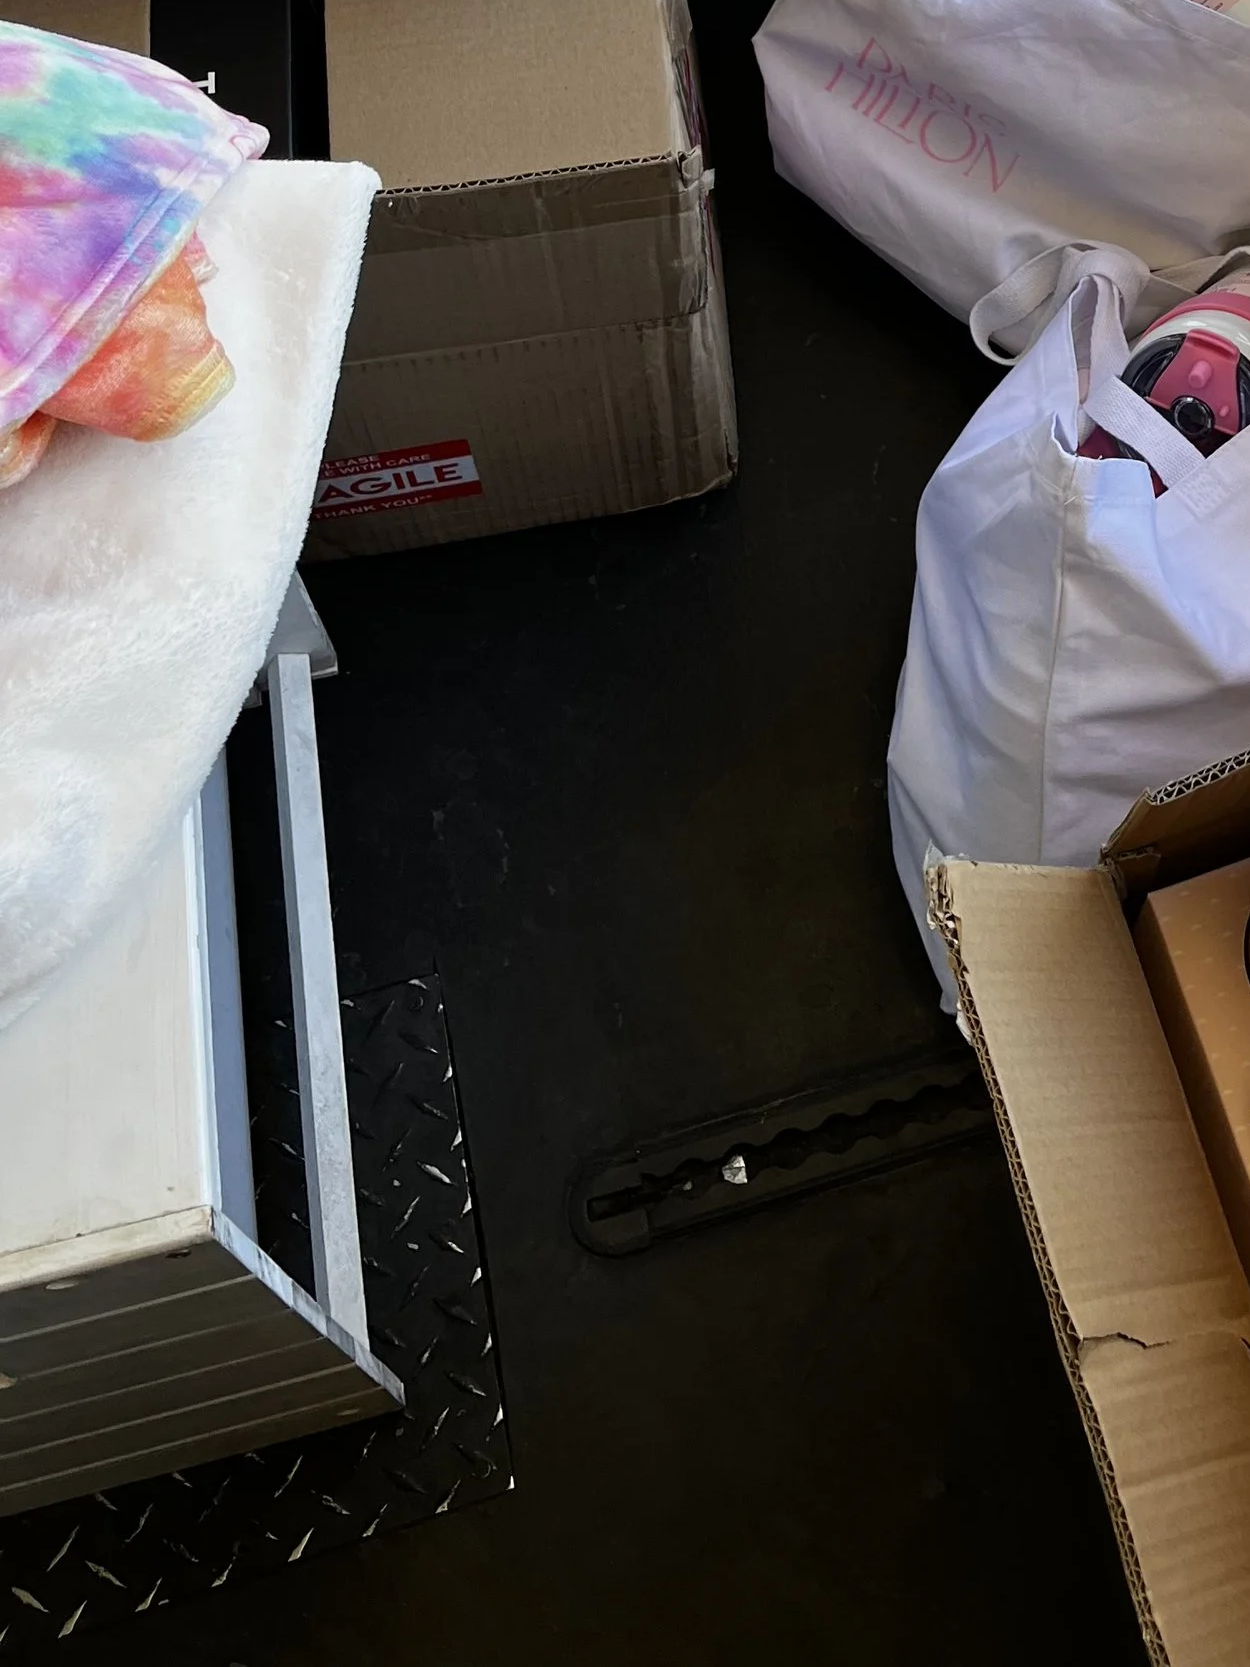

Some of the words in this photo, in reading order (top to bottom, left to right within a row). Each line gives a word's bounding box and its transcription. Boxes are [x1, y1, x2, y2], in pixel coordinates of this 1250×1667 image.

[824, 61, 1022, 193] HILTON
[318, 463, 463, 503] AGILE
[341, 462, 382, 475] WITH
[386, 454, 432, 467] CARE
